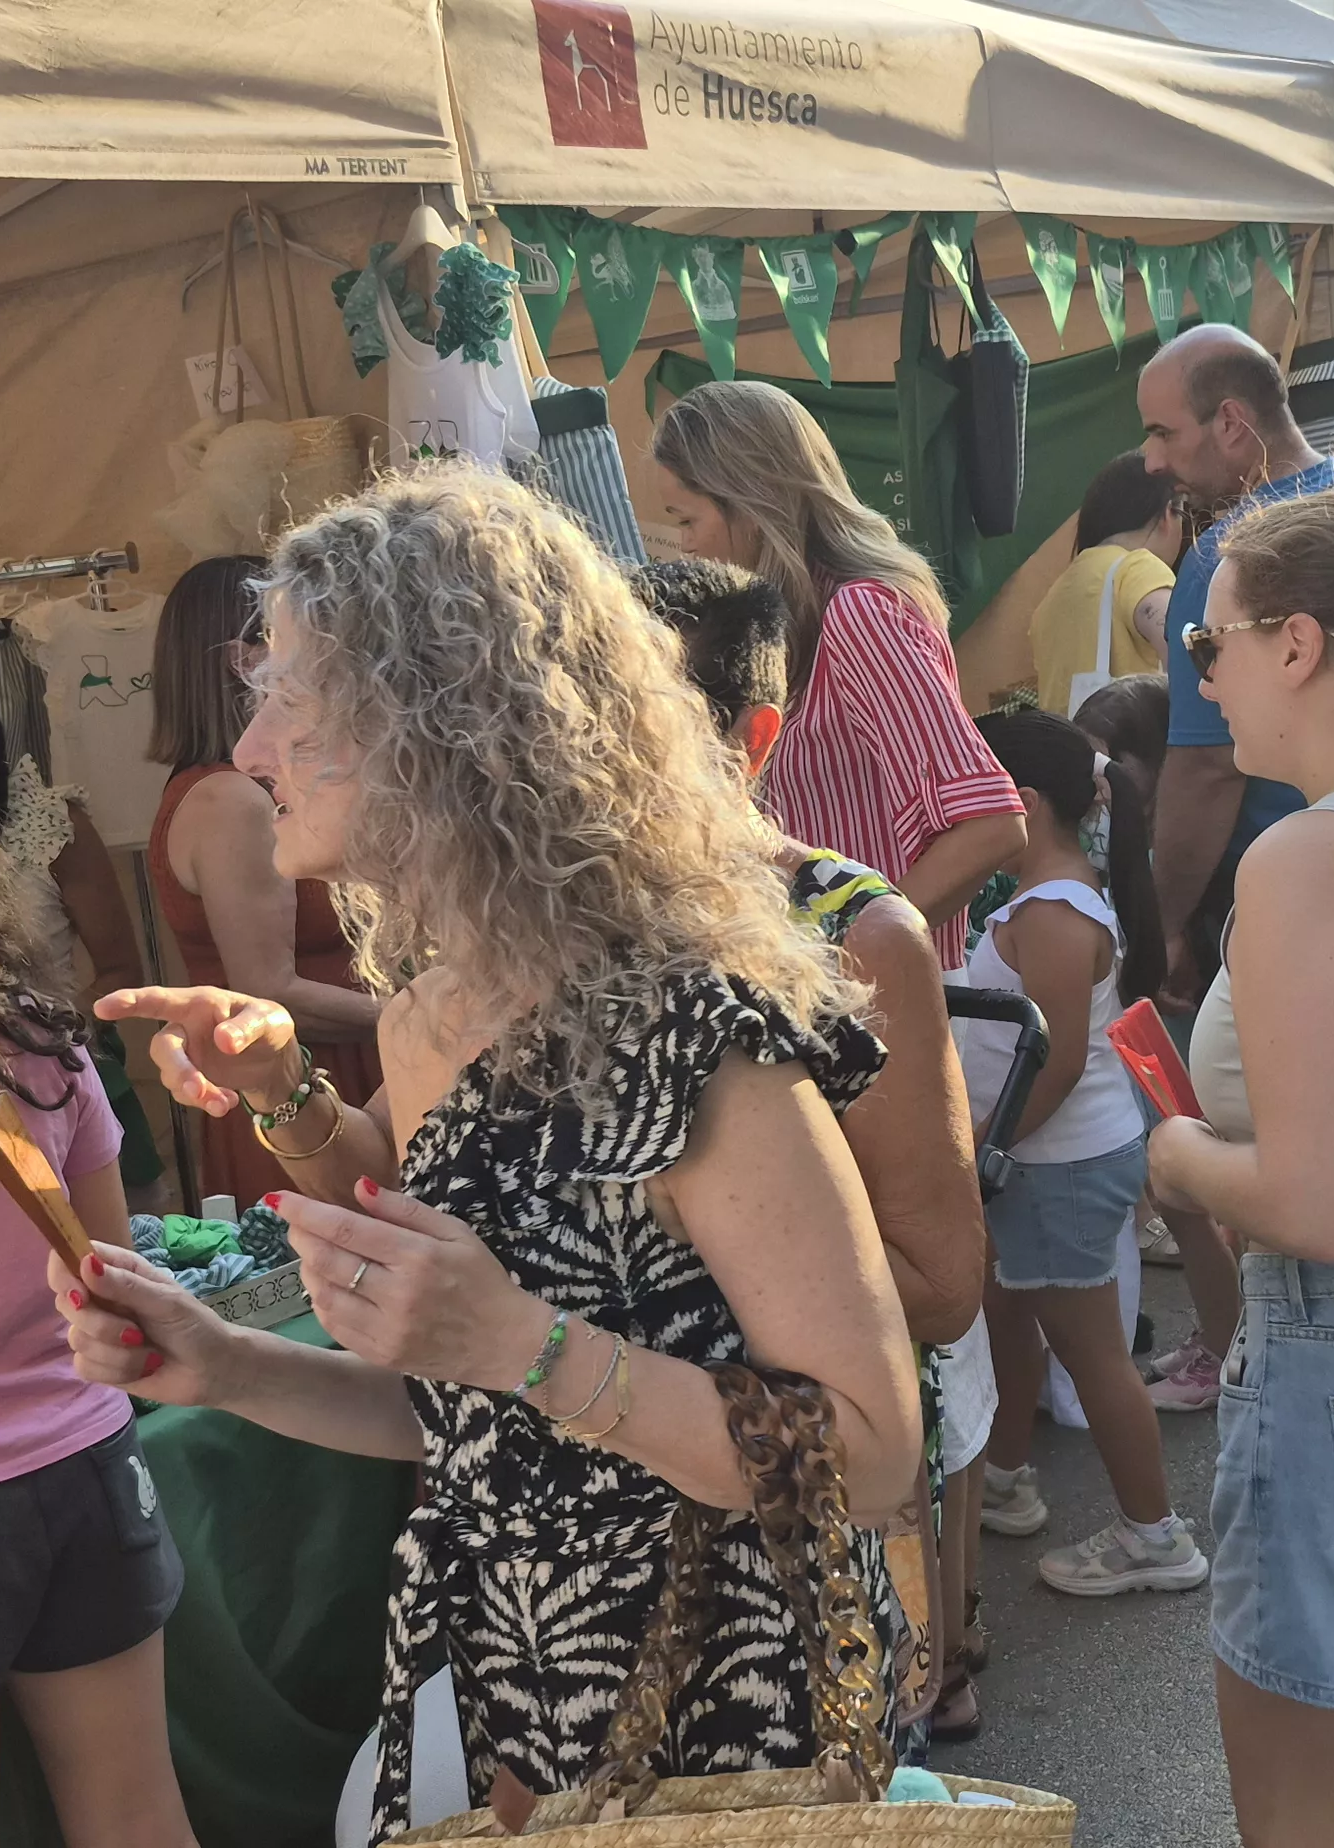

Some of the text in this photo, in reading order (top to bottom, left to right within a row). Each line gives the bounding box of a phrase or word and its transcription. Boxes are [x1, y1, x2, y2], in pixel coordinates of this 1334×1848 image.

[650, 9, 864, 70] Ayuntamiento
[653, 70, 818, 126] de Huesca
[336, 157, 408, 176] TERTENT
